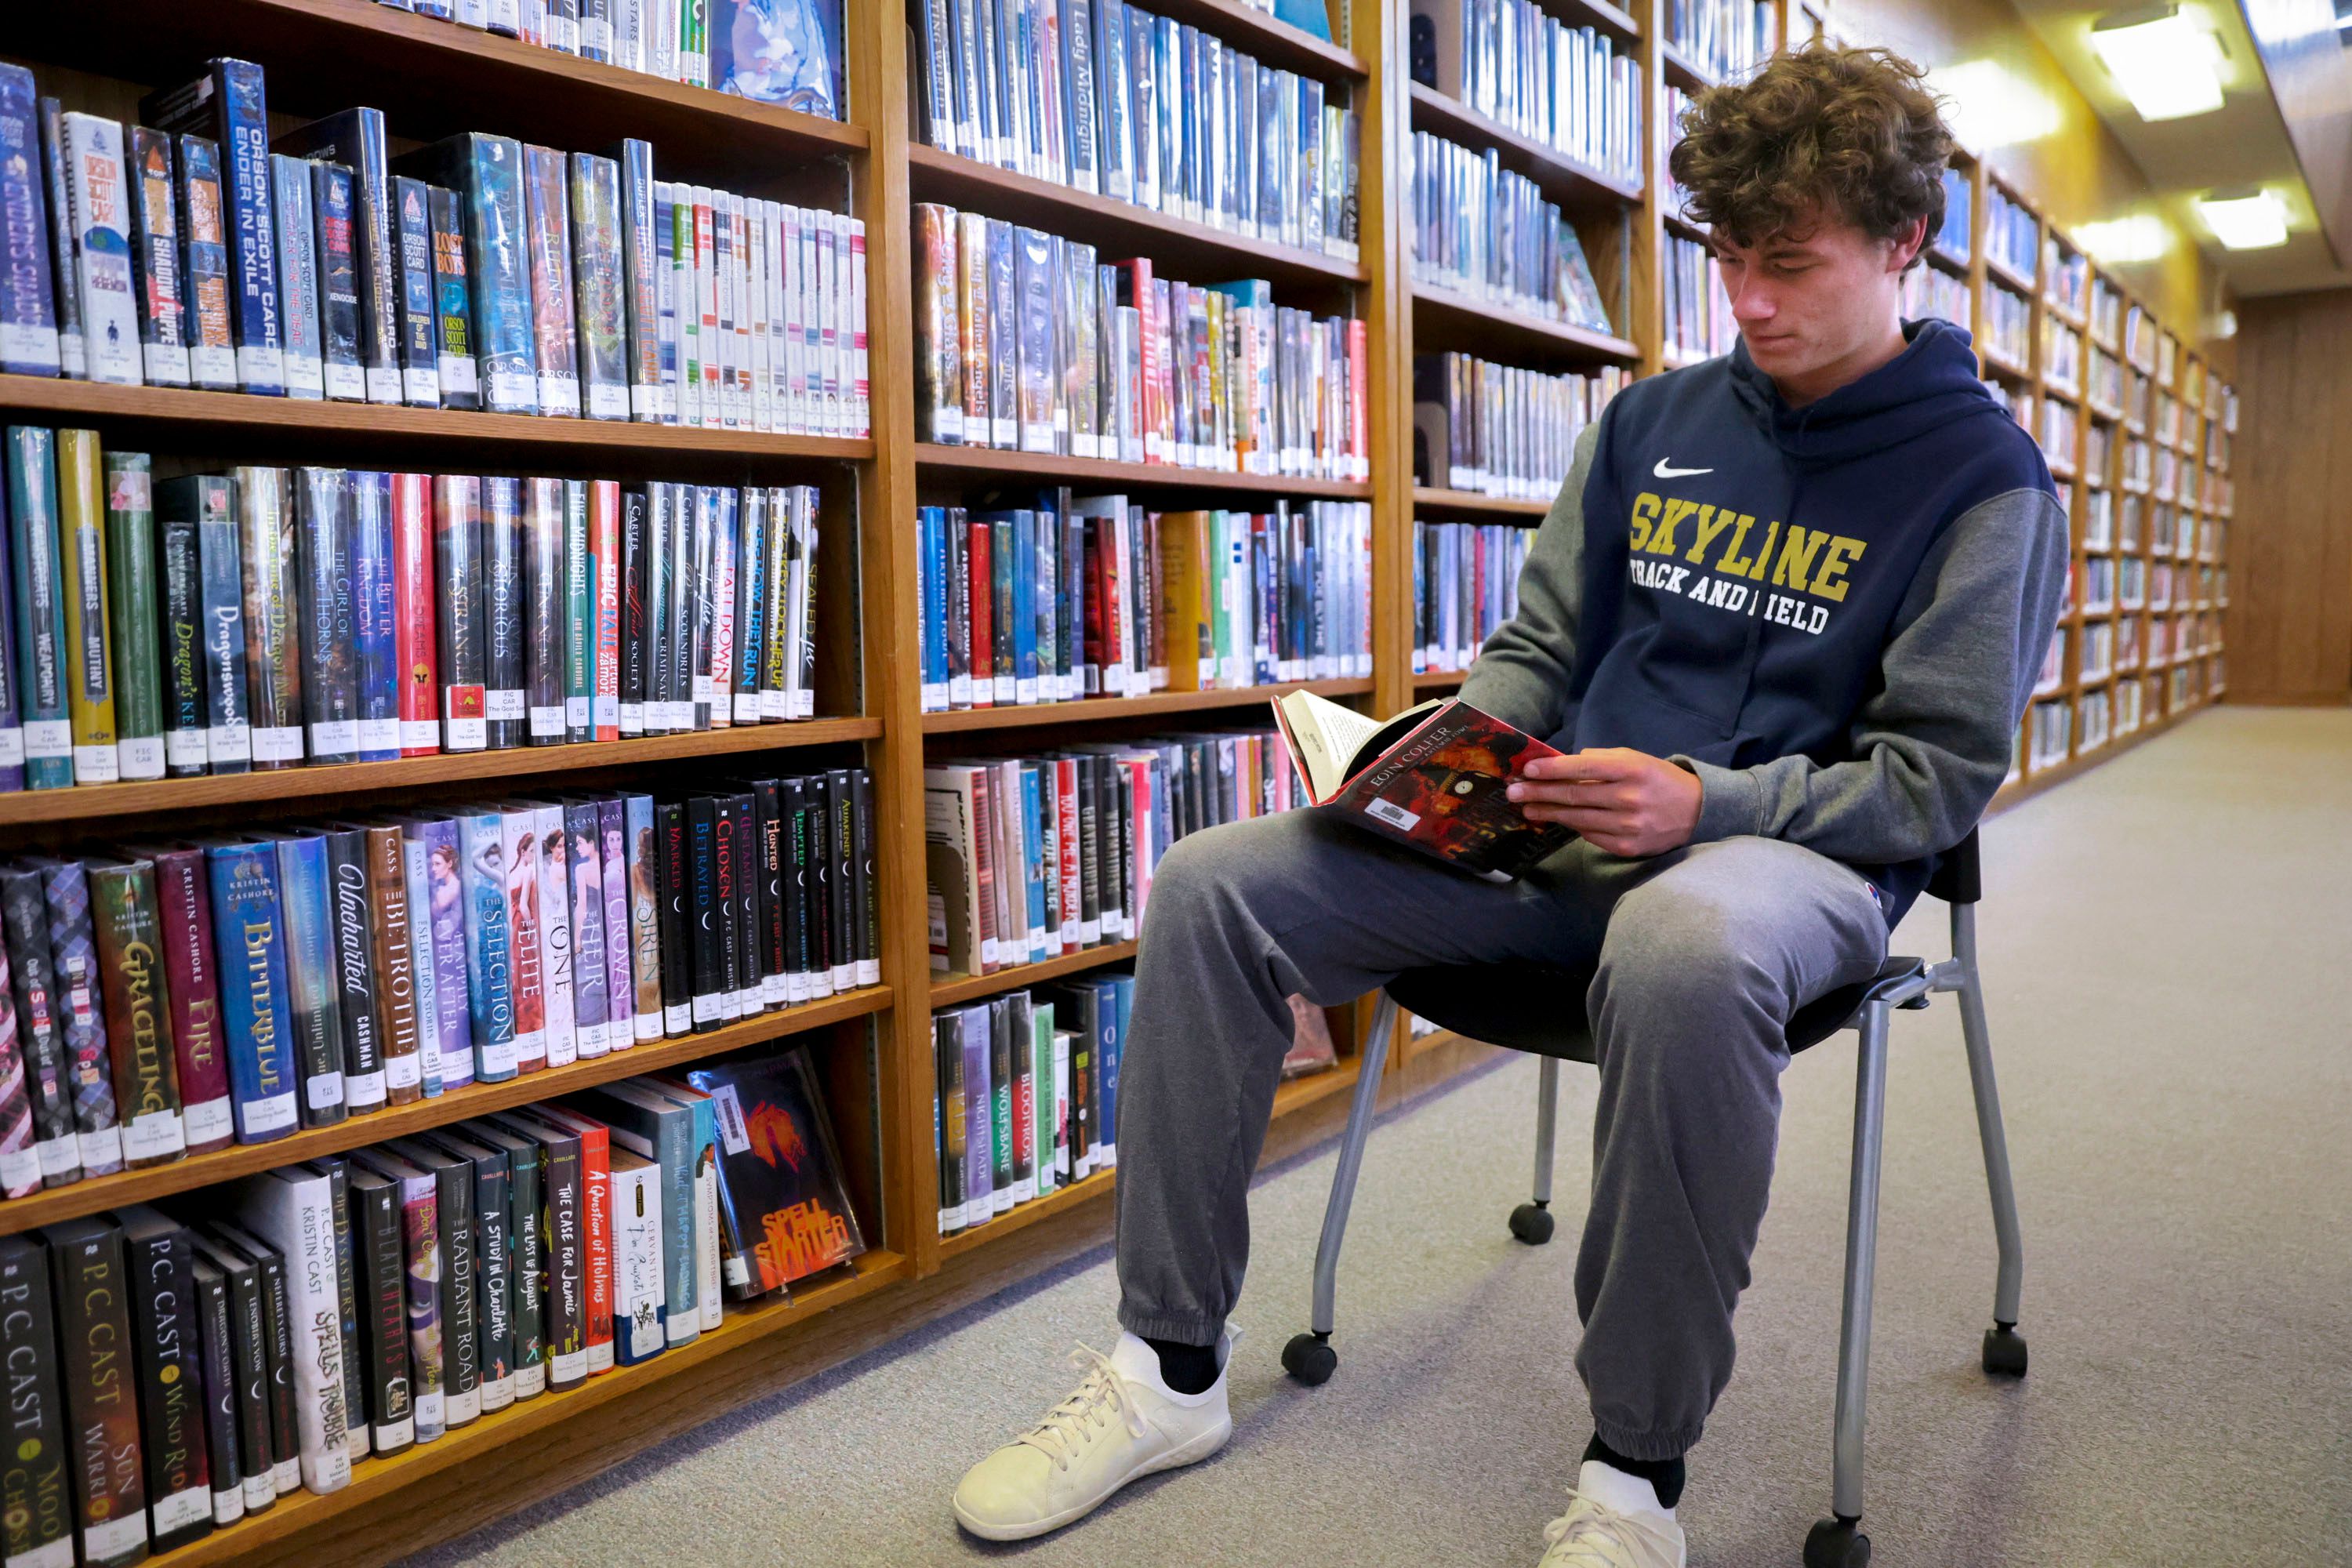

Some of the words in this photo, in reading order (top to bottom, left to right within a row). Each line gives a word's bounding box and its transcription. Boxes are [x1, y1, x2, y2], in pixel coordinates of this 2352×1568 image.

[1072, 9, 1087, 62] Lady
[1076, 65, 1091, 159] Midnight
[236, 126, 253, 201] ENDER
[250, 128, 268, 207] ORSON
[241, 208, 254, 230] IN
[403, 233, 426, 246] ORSON
[435, 230, 464, 254] LOST
[153, 238, 175, 299] SHADOW
[244, 237, 260, 296] EXILE
[256, 214, 272, 285] SCOTT
[288, 259, 299, 283] FOR
[404, 245, 426, 258] SCOTT
[406, 256, 425, 270] CARD
[437, 252, 466, 276] BOYS
[546, 232, 564, 308] RUINS
[938, 241, 956, 289] City
[261, 292, 277, 349] CARD
[289, 287, 301, 309] THE
[445, 316, 465, 330] ORSON
[386, 301, 396, 349] CARD
[445, 330, 466, 345] SCOTT
[941, 312, 957, 376] Glass
[973, 304, 986, 354] Fallen
[1002, 307, 1012, 343] Lost
[974, 360, 987, 413] Angels
[1003, 346, 1014, 392] Souls
[569, 492, 586, 518] FIVE
[630, 506, 641, 551] CARTER
[660, 496, 670, 543] CARTER
[682, 496, 692, 542] CARTER
[335, 550, 346, 575] THE
[570, 525, 587, 597] MIDNIGHTS
[1629, 492, 1867, 603] SKYLINE
[336, 577, 349, 617] GIRL
[358, 557, 376, 637] KINGDOM
[488, 559, 510, 659] GLORIOUS
[961, 550, 971, 615] ARTEMIS
[1630, 559, 1690, 593] TRACK
[1688, 575, 1748, 612] AND
[318, 594, 334, 664] THORNS
[601, 608, 617, 650] FAIL
[680, 609, 689, 688] SCOUNDRELS
[713, 614, 734, 683] DOWN
[750, 610, 764, 650] THEY
[768, 640, 783, 669] HER
[38, 631, 56, 705] WEAPONRY
[87, 635, 103, 689] MUTINY
[173, 620, 198, 698] Dragon's
[212, 605, 243, 727] Dragonswood
[630, 640, 639, 691] SOCIETY
[659, 636, 668, 702] CRIMINALS
[742, 649, 758, 687] RUN
[771, 669, 783, 688] UP
[1370, 761, 1404, 787] EOIN
[1402, 726, 1452, 763] COLFER
[842, 799, 852, 858] AWAKENED
[1060, 793, 1075, 815] YOU
[1062, 818, 1076, 838] OWE
[385, 837, 398, 873] CASS
[476, 829, 499, 838] CASS
[670, 827, 682, 888] MARKED
[717, 820, 734, 898] CHOSEN
[739, 816, 753, 894] UNTAMED
[795, 810, 807, 866] TEMPTED
[1063, 841, 1077, 861] ME
[229, 878, 272, 889] KRISTIN
[414, 851, 423, 877] CASS
[695, 822, 710, 906] BETRAYED
[1047, 866, 1060, 912] MALICE
[1064, 862, 1078, 873] A
[182, 867, 196, 920] KRISTIN
[227, 888, 274, 901] CASHORE
[1062, 875, 1079, 922] MURDER
[187, 924, 203, 984] CASHORE
[337, 863, 369, 998] Uncharted
[357, 1014, 373, 1069] CASHMAN
[417, 926, 432, 1000] SELECTION
[437, 919, 455, 966] EVER
[517, 928, 540, 999] ELITE
[550, 925, 572, 995] ONE
[580, 918, 604, 998] HEIR
[608, 898, 630, 1001] CROWN
[637, 907, 660, 982] SIREN
[453, 933, 469, 1012] HAPPILY
[483, 909, 511, 1043] SELECTION
[119, 941, 165, 1116] GRACELING
[243, 916, 280, 1095] BITTERBLUE
[424, 1000, 435, 1040] STORIES
[440, 972, 457, 1033] AFTER
[185, 993, 217, 1072] FIRE
[975, 1093, 989, 1184] NIGHTSHADE
[998, 1083, 1011, 1173] WOLFSBANE
[1021, 1072, 1033, 1167] BLOODROSE
[557, 1182, 572, 1207] THE
[588, 1170, 607, 1181] A
[302, 1206, 320, 1256] KRISTIN
[523, 1213, 535, 1233] THE
[559, 1210, 574, 1242] CASE
[587, 1185, 605, 1236] Question
[677, 1204, 689, 1249] HAPPY
[760, 1196, 823, 1229] SPELL
[150, 1238, 173, 1284] P.C.
[322, 1235, 336, 1270] CAST
[334, 1218, 354, 1315] DYSASTERS
[488, 1225, 503, 1261] STUDY
[488, 1262, 503, 1276] IN
[524, 1236, 536, 1257] LAST
[561, 1246, 574, 1267] FOR
[592, 1239, 606, 1254] of
[647, 1220, 657, 1288] CERVANTES
[82, 1261, 112, 1318] P.C.
[307, 1260, 322, 1295] CAST
[377, 1225, 405, 1364] BLACKHEARTS
[452, 1229, 472, 1327] RADIANT
[521, 1269, 540, 1312] August
[561, 1269, 578, 1317] Jamie
[593, 1256, 608, 1303] Holmes
[626, 1253, 647, 1293] Quixote
[679, 1256, 689, 1311] ENDINGS
[154, 1290, 181, 1360] CAST
[216, 1300, 229, 1355] DRAGON'S
[249, 1297, 262, 1348] LENOBIA'S
[274, 1277, 287, 1327] NEFERET'S
[488, 1277, 507, 1342] Charlotte
[88, 1322, 122, 1405] CAST
[311, 1310, 341, 1379] SPELLS
[457, 1331, 474, 1392] ROAD
[7, 1345, 43, 1431] CAST
[165, 1385, 188, 1444] WIND
[318, 1379, 347, 1450] TROUBLE
[111, 1443, 137, 1494] SUN
